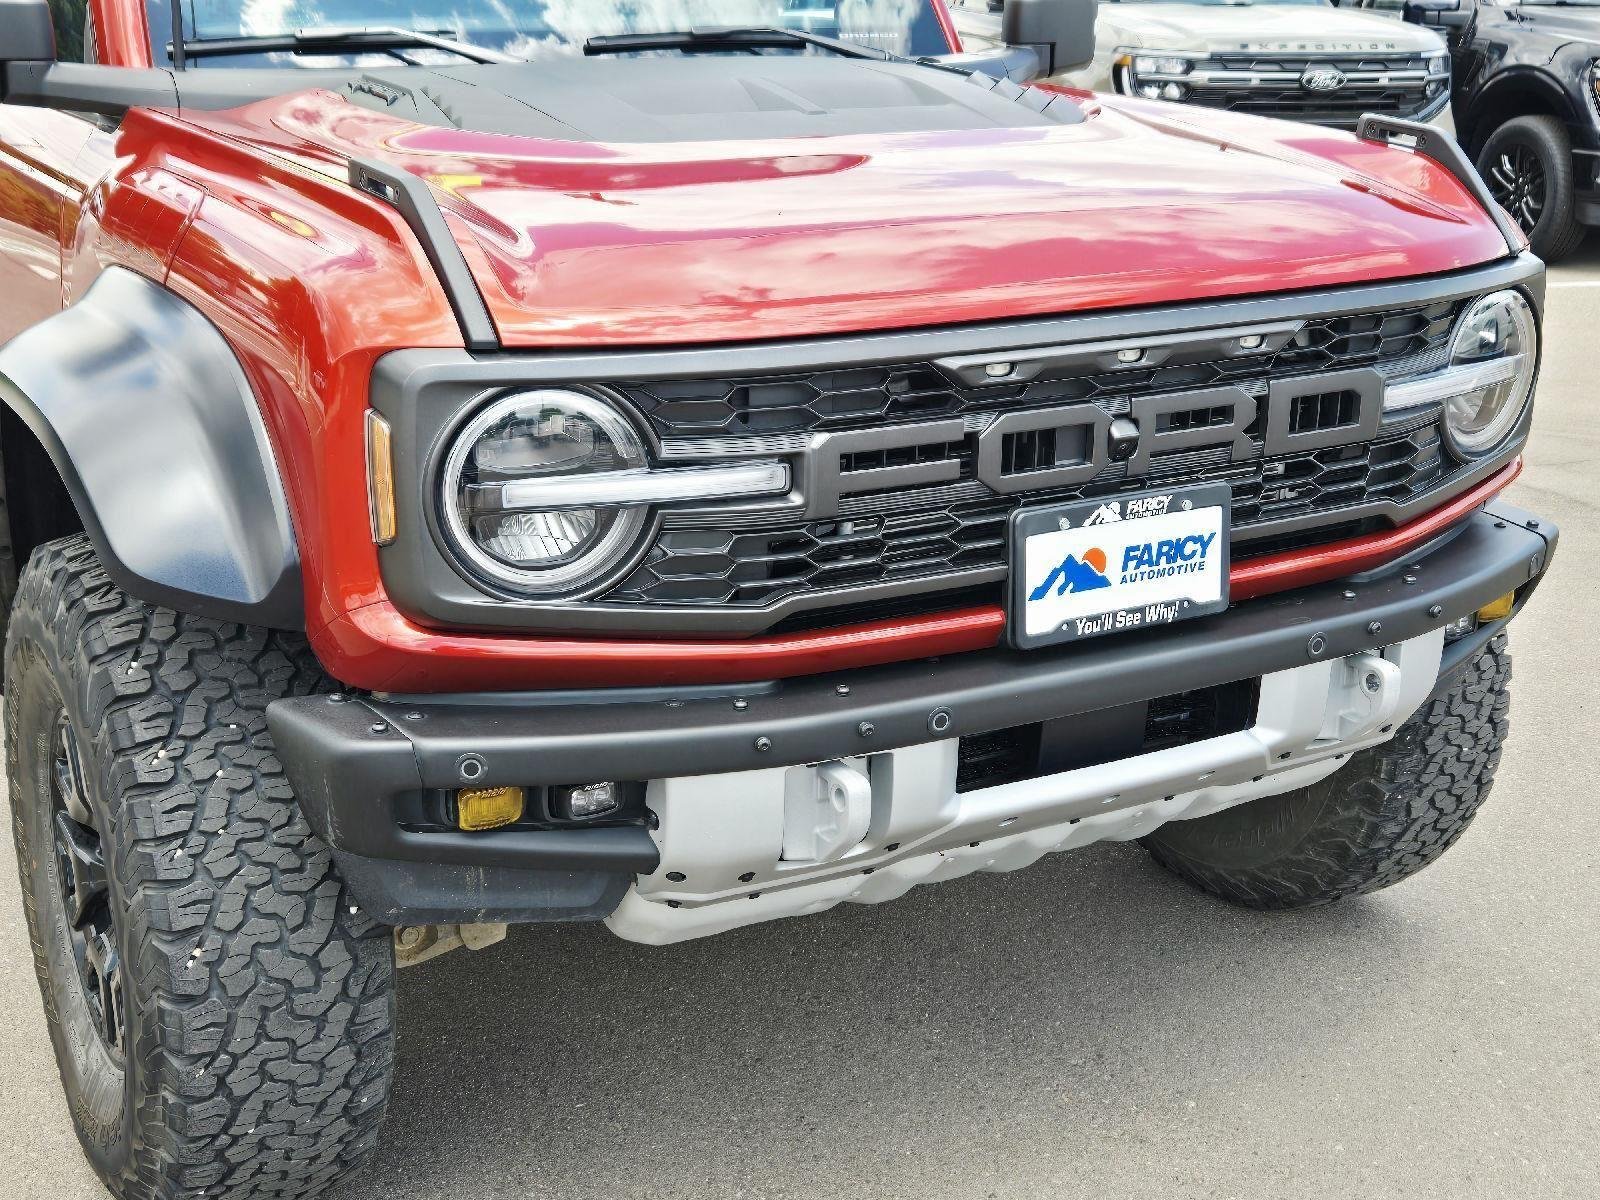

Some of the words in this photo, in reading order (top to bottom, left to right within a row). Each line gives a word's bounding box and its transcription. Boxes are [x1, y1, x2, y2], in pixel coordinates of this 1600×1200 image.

[1239, 42, 1396, 51] EXPEDITION
[803, 367, 1384, 520] FORD
[1127, 495, 1173, 514] FARICY
[1121, 532, 1216, 572] FARICY
[1120, 561, 1205, 585] AUTOMOTIVE
[1075, 614, 1113, 636] You'll
[1116, 610, 1141, 630] See
[1145, 601, 1180, 623] Why!
